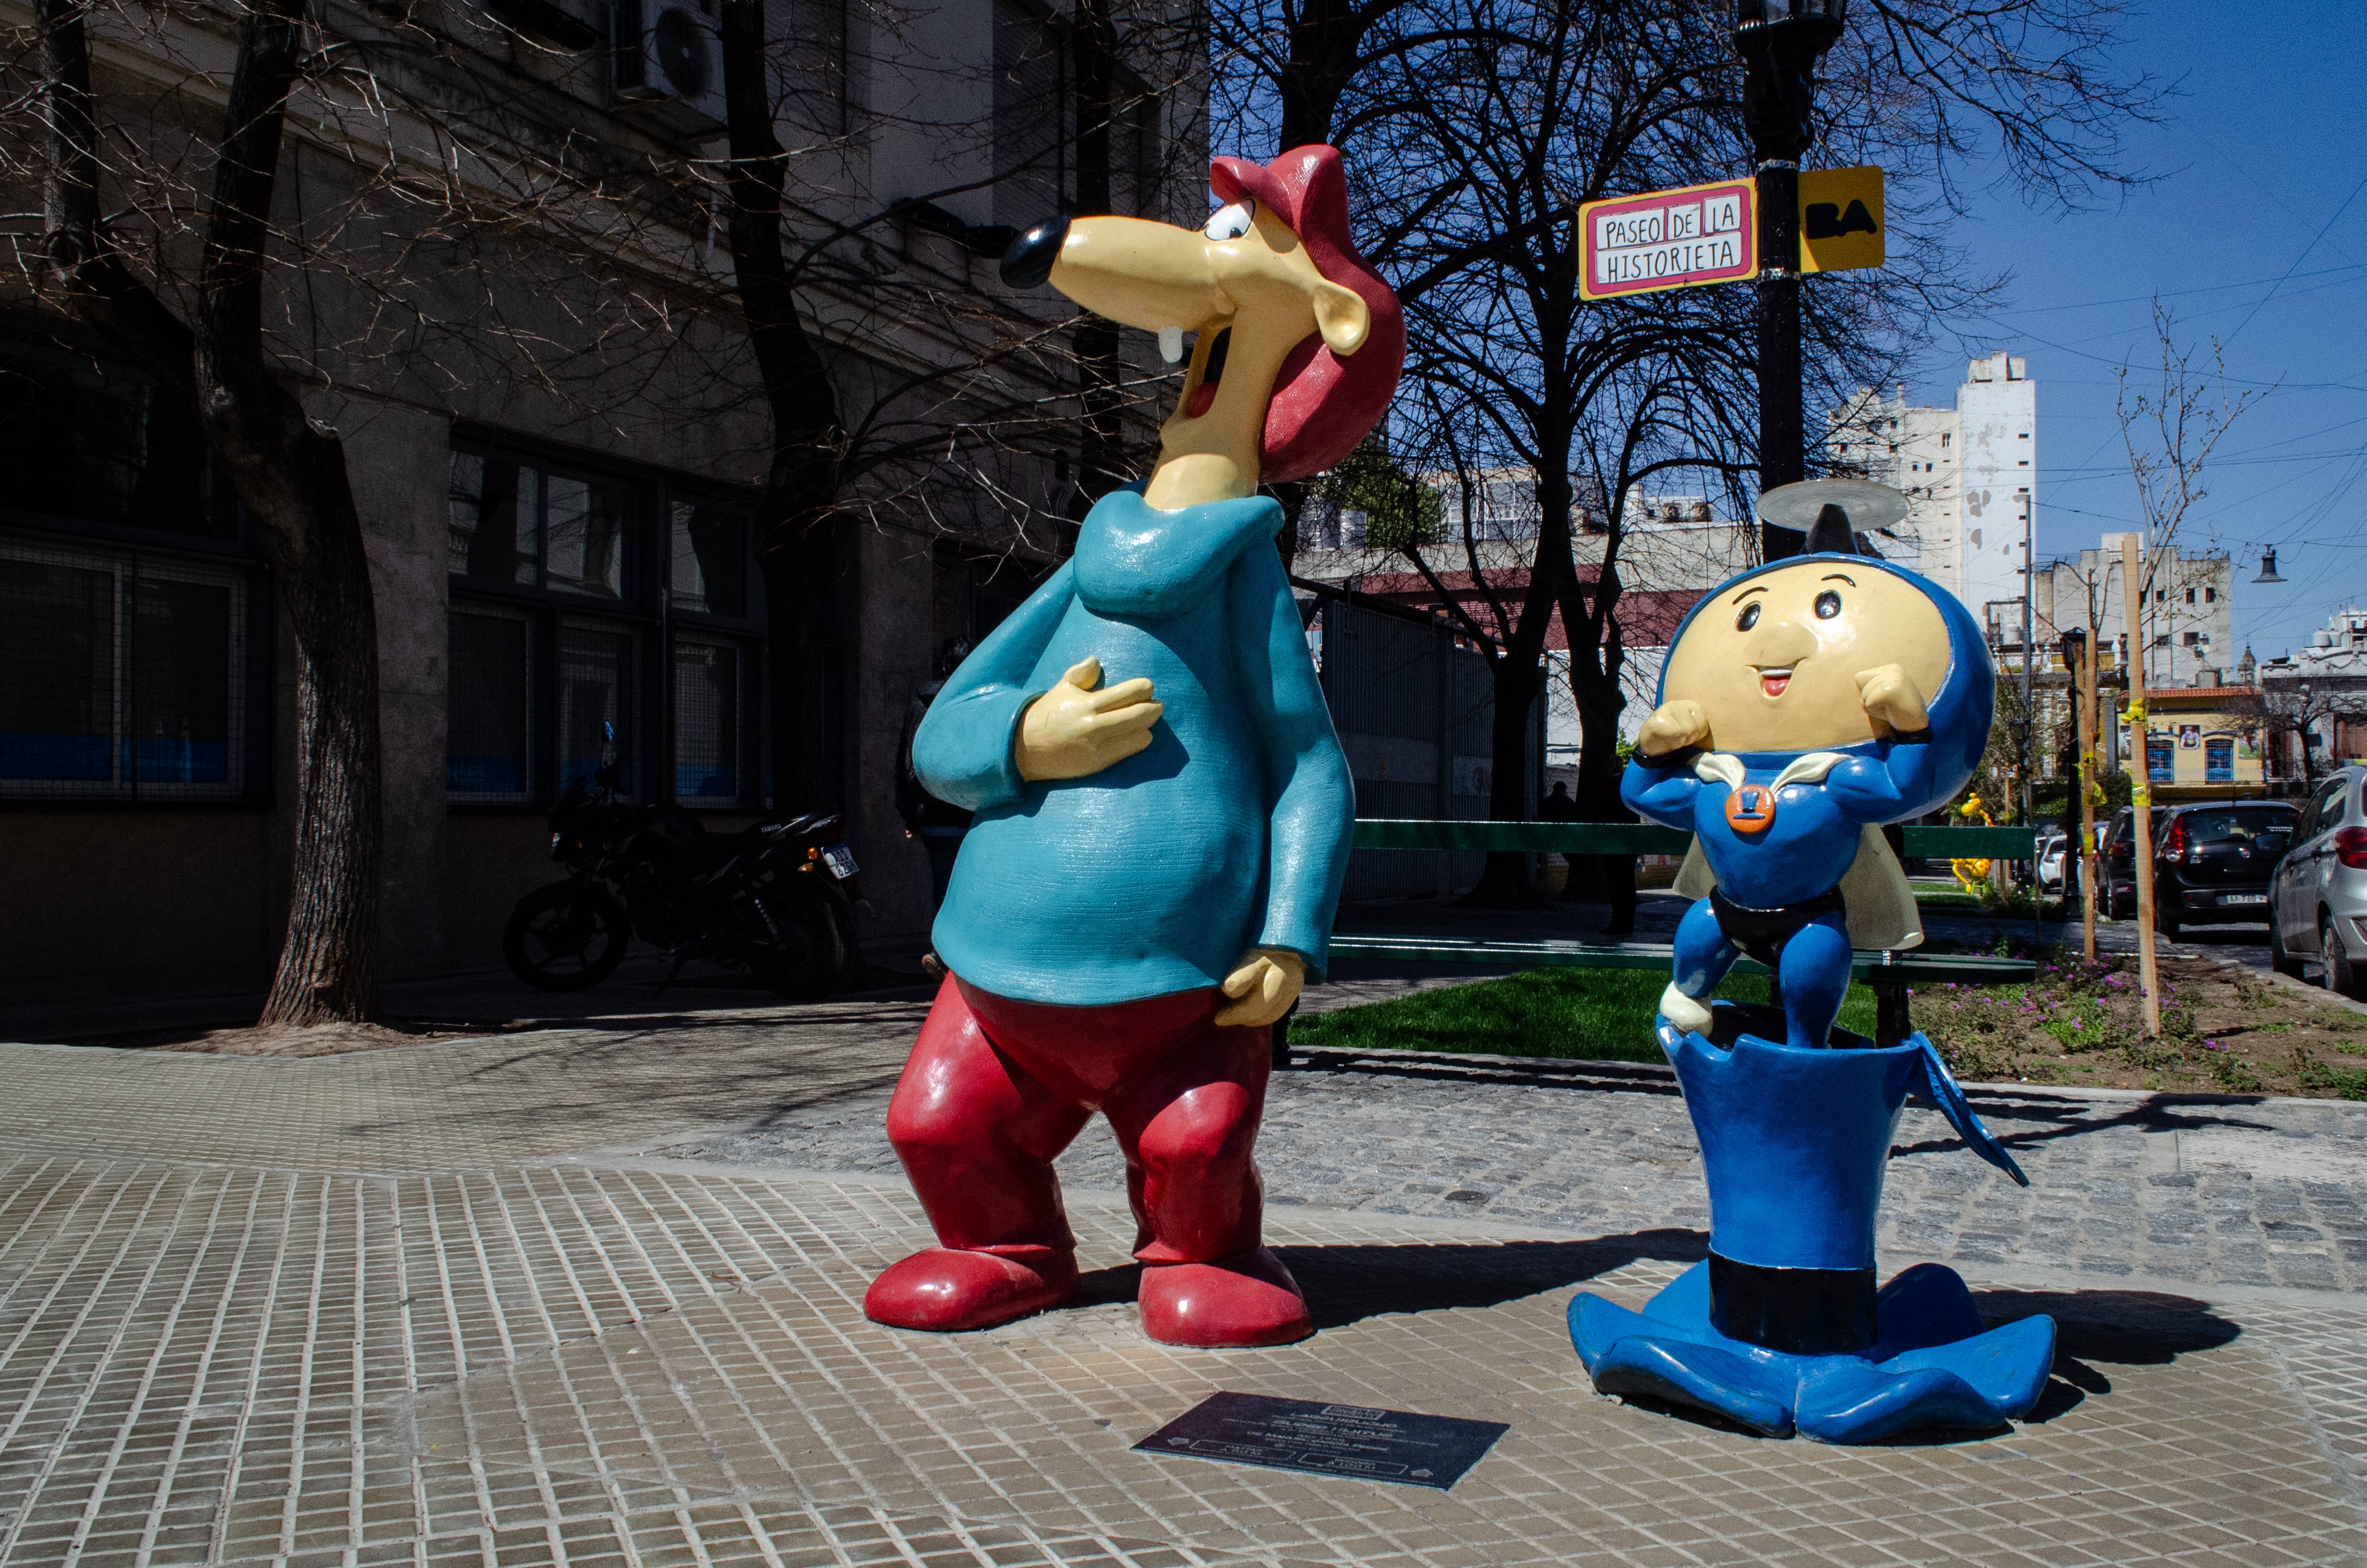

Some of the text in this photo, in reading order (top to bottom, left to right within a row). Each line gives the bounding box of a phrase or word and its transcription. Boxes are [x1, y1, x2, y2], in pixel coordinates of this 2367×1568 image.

[1606, 203, 1734, 248] PASEO DE LA
[1805, 199, 1878, 239] BA
[1608, 240, 1733, 283] HISTORIETA
